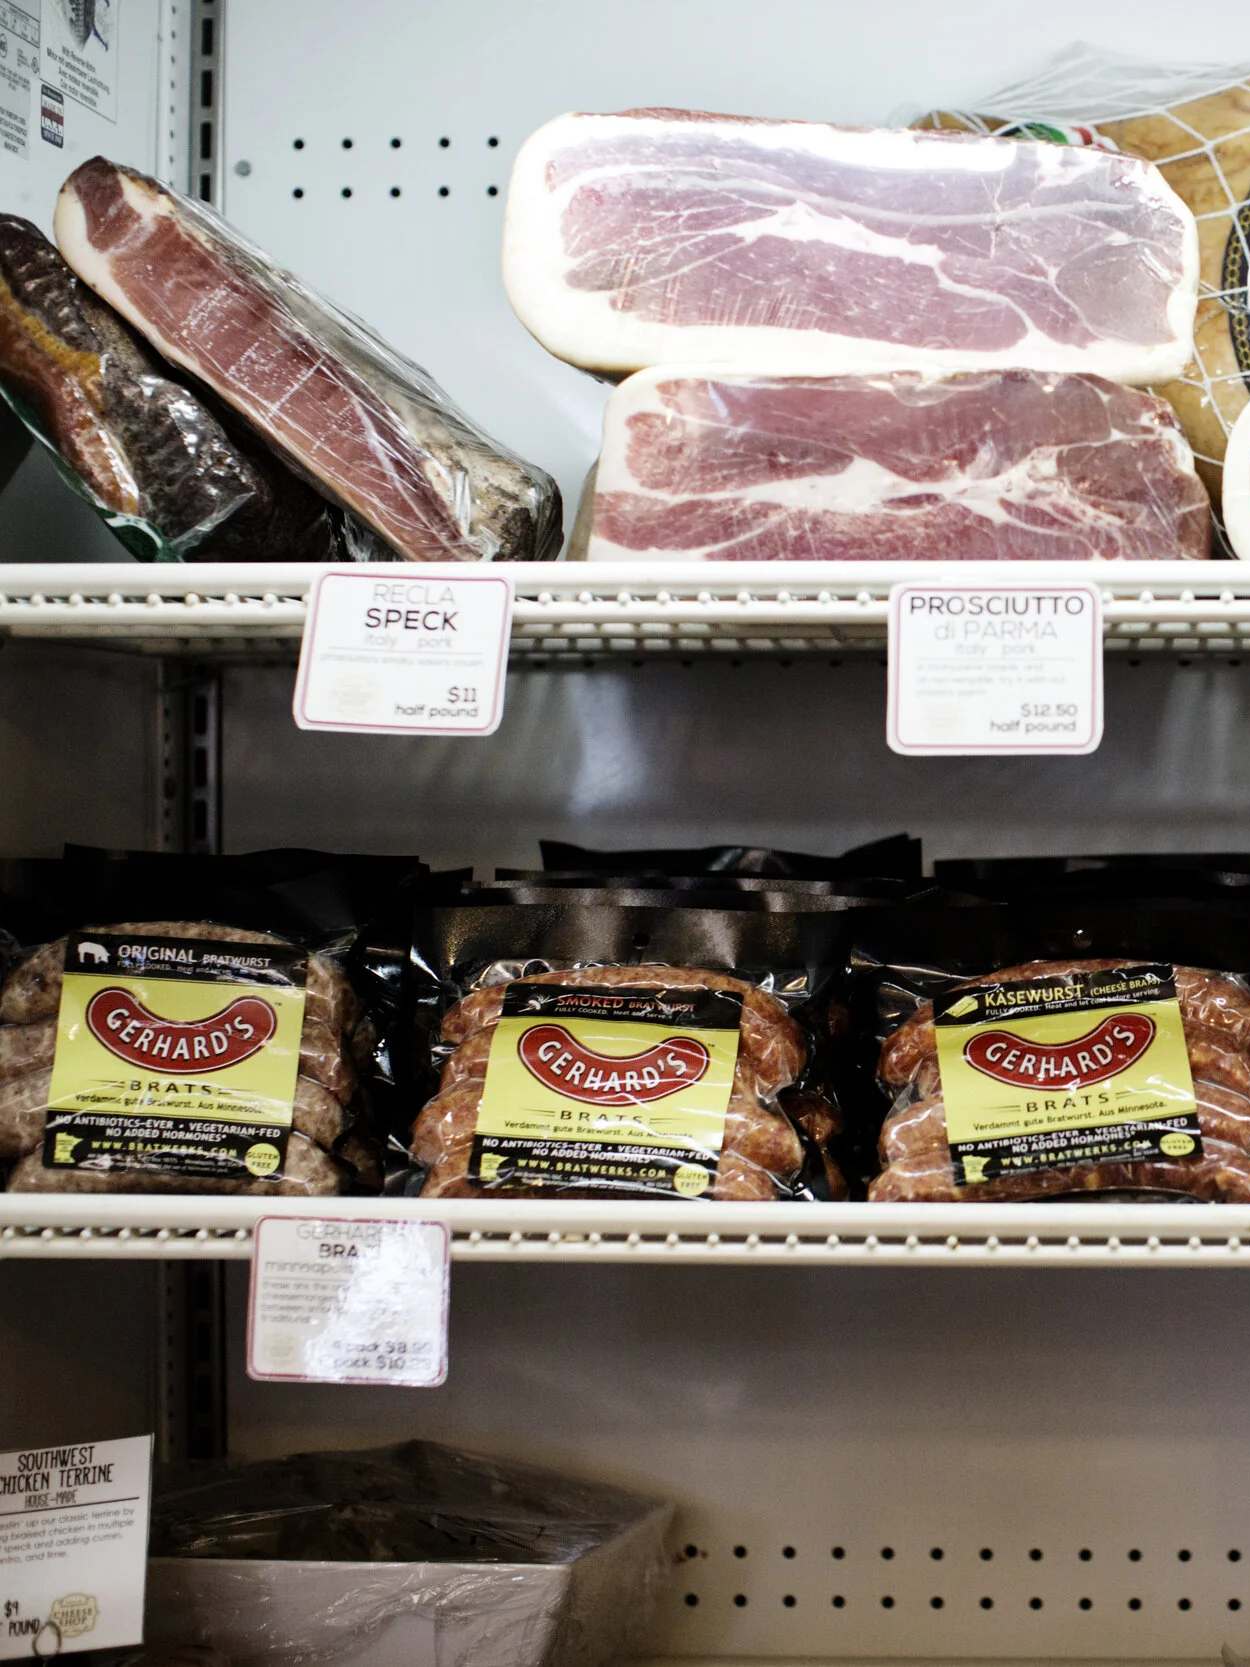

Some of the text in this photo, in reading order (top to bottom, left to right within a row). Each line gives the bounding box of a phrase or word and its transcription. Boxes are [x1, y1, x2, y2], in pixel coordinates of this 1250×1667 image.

[373, 583, 456, 605] RECLA
[910, 596, 1084, 615] PROSCIUTTO
[365, 608, 458, 631] SPECK
[934, 620, 1058, 641] di PARMA
[417, 636, 453, 650] pork
[447, 686, 478, 704] $11
[394, 704, 479, 719] half pound
[989, 719, 1077, 735] half pound
[118, 944, 271, 968] ORIGINAL BRATWURST
[985, 983, 1084, 1007] KÄSEWURST
[1090, 981, 1128, 997] (CHEESE
[985, 1006, 1009, 1017] FULLY
[1045, 1001, 1063, 1010] Heat
[1064, 1000, 1078, 1008] and
[1079, 998, 1090, 1006] let
[1131, 987, 1161, 999] serving.
[554, 1006, 576, 1014] FULLY
[578, 1007, 609, 1016] COOKED.
[613, 1009, 630, 1017] Heat
[557, 996, 695, 1013] SMOKED BRATWURST
[106, 1006, 255, 1061] GERHARD'S
[985, 1025, 1136, 1079] GERHARD'S
[538, 1040, 688, 1093] GERHARD'S
[130, 1080, 213, 1096] BRATS
[198, 1100, 213, 1110] Aus
[1026, 1092, 1110, 1113] BRATS
[560, 1110, 643, 1125] BRATS
[973, 1100, 1168, 1132] Verdammt gute Bratwurst. Aus Minnesota.
[105, 1127, 122, 1138] NO
[124, 1128, 160, 1140] ADDED
[189, 1122, 281, 1138] VEGETARIAN-FED
[553, 1123, 573, 1134] gute
[576, 1125, 624, 1137] Bratwurst.
[628, 1129, 643, 1138] Aus
[483, 1138, 499, 1148] NO
[957, 1143, 975, 1153] NO
[1012, 1142, 1029, 1154] NO
[1030, 1137, 1068, 1151] ADDED
[245, 1151, 279, 1161] GLUTEN
[532, 1147, 549, 1158] NO
[551, 1148, 588, 1160] ADDED
[251, 1160, 271, 1170] FREE
[518, 1158, 667, 1178] WWW.BRATWERKS.COM
[18, 1446, 96, 1472] SOUTHWEST
[59, 1463, 115, 1488] TERRINE
[25, 1490, 78, 1509] HOUSE-MADE
[41, 1517, 57, 1526] our
[58, 1513, 89, 1524] classic
[91, 1509, 121, 1520] terrine
[122, 1507, 135, 1518] by
[11, 1529, 46, 1541] braised
[48, 1525, 86, 1537] chicken
[98, 1518, 135, 1532] multiple
[34, 1538, 54, 1549] and
[55, 1535, 90, 1549] adding
[25, 1552, 45, 1562] and
[54, 1607, 93, 1619] CHEESE
[8, 1618, 41, 1637] POUND
